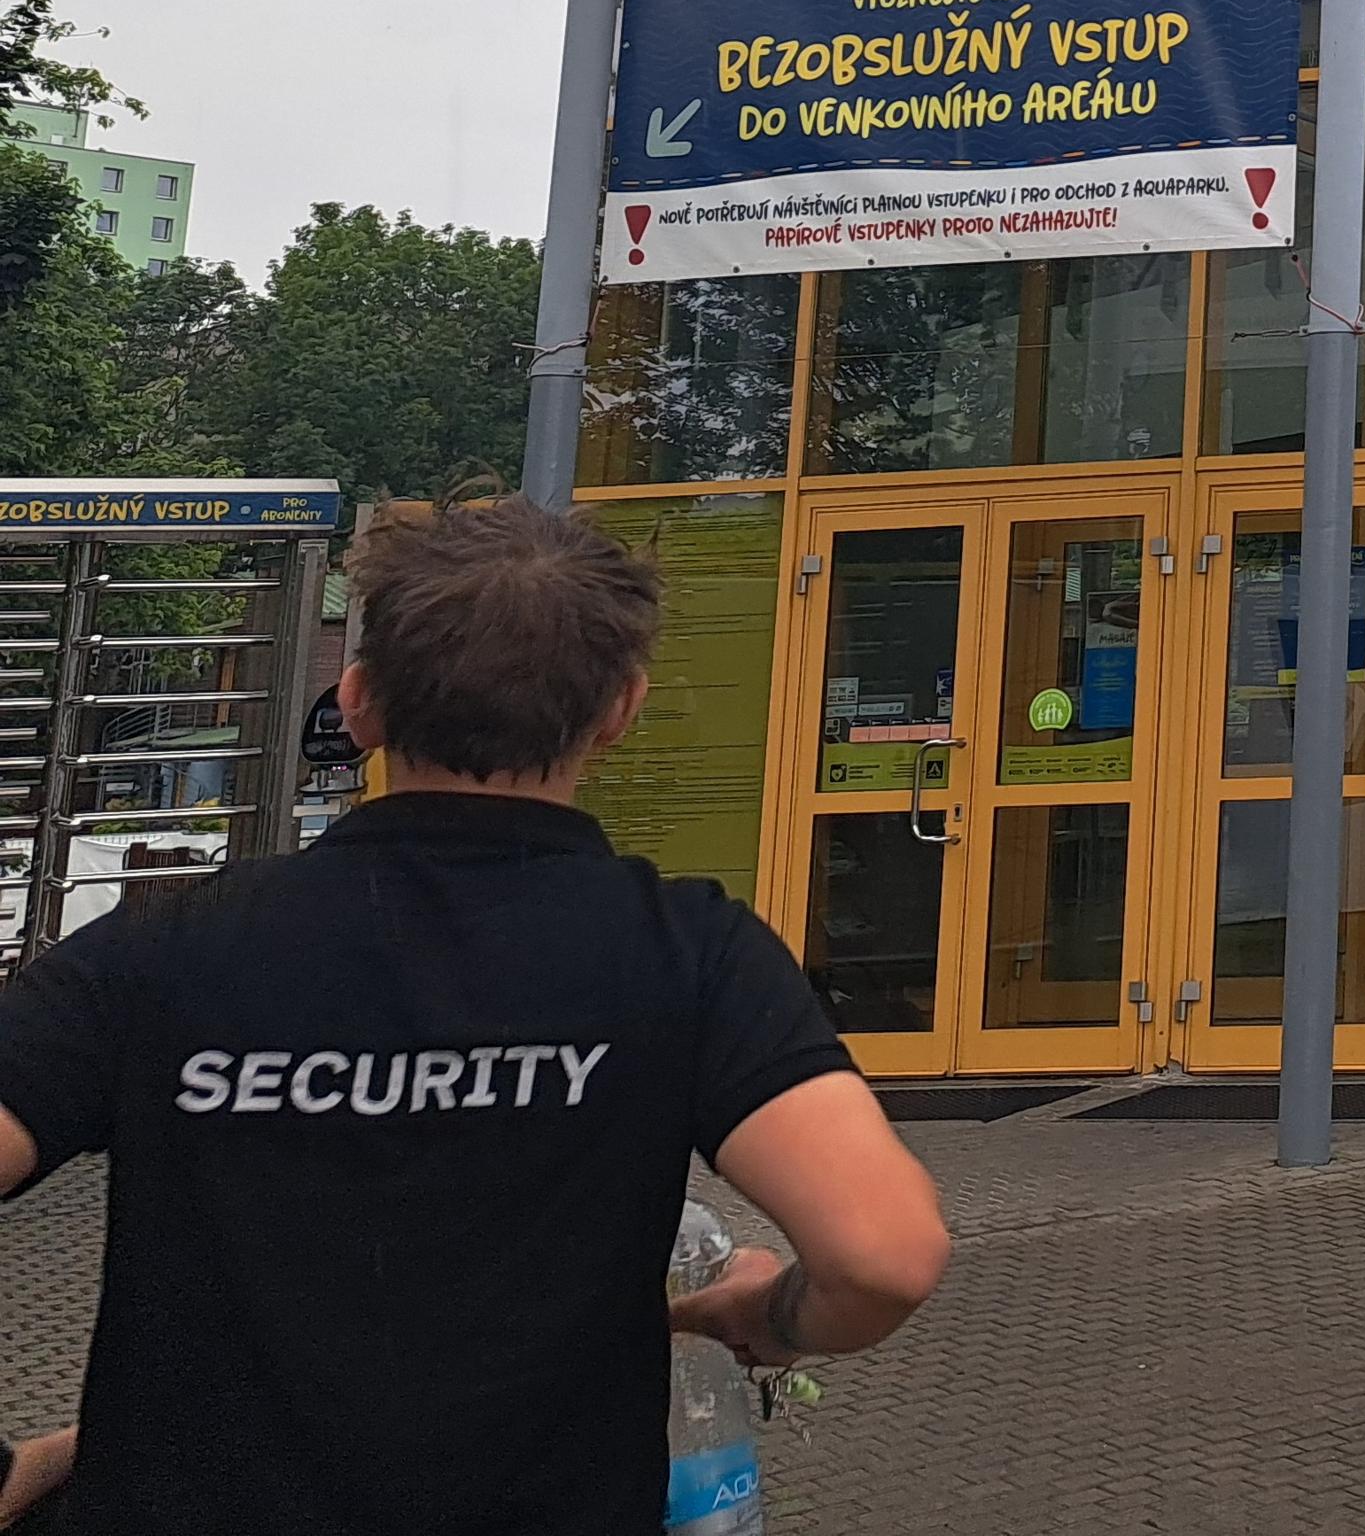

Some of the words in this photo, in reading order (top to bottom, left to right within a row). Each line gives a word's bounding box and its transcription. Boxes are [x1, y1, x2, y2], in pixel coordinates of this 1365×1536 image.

[719, 5, 1032, 91] BEZOBSLUŽNÝ
[1050, 12, 1188, 67] VSTUP
[740, 106, 785, 139] DO
[800, 83, 1011, 138] VENKOVNÍHO
[1023, 70, 1156, 123] AREÁLU
[659, 202, 692, 224] NOVĚ
[696, 199, 770, 224] POTŘEBUJÍ
[773, 194, 858, 224] NÁVŠTĚVNÍCI
[862, 194, 921, 213] PLATNOU
[927, 189, 1006, 208] VSTUPENKU
[1021, 188, 1050, 204] PRO
[1055, 183, 1116, 200] ODCHOD
[1122, 182, 1129, 197] Z
[1134, 177, 1229, 197] AQUAPARKU.
[766, 224, 841, 247] PAPÍROVÉ
[849, 220, 935, 240] VSTUPENKY
[943, 218, 993, 234] PROTO
[1000, 208, 1114, 233] NEZAHAZUJTE!
[155, 502, 230, 521] VSTUP
[260, 510, 322, 522] ABONENTY
[283, 497, 308, 508] PRO
[175, 1043, 611, 1115] SECURITY
